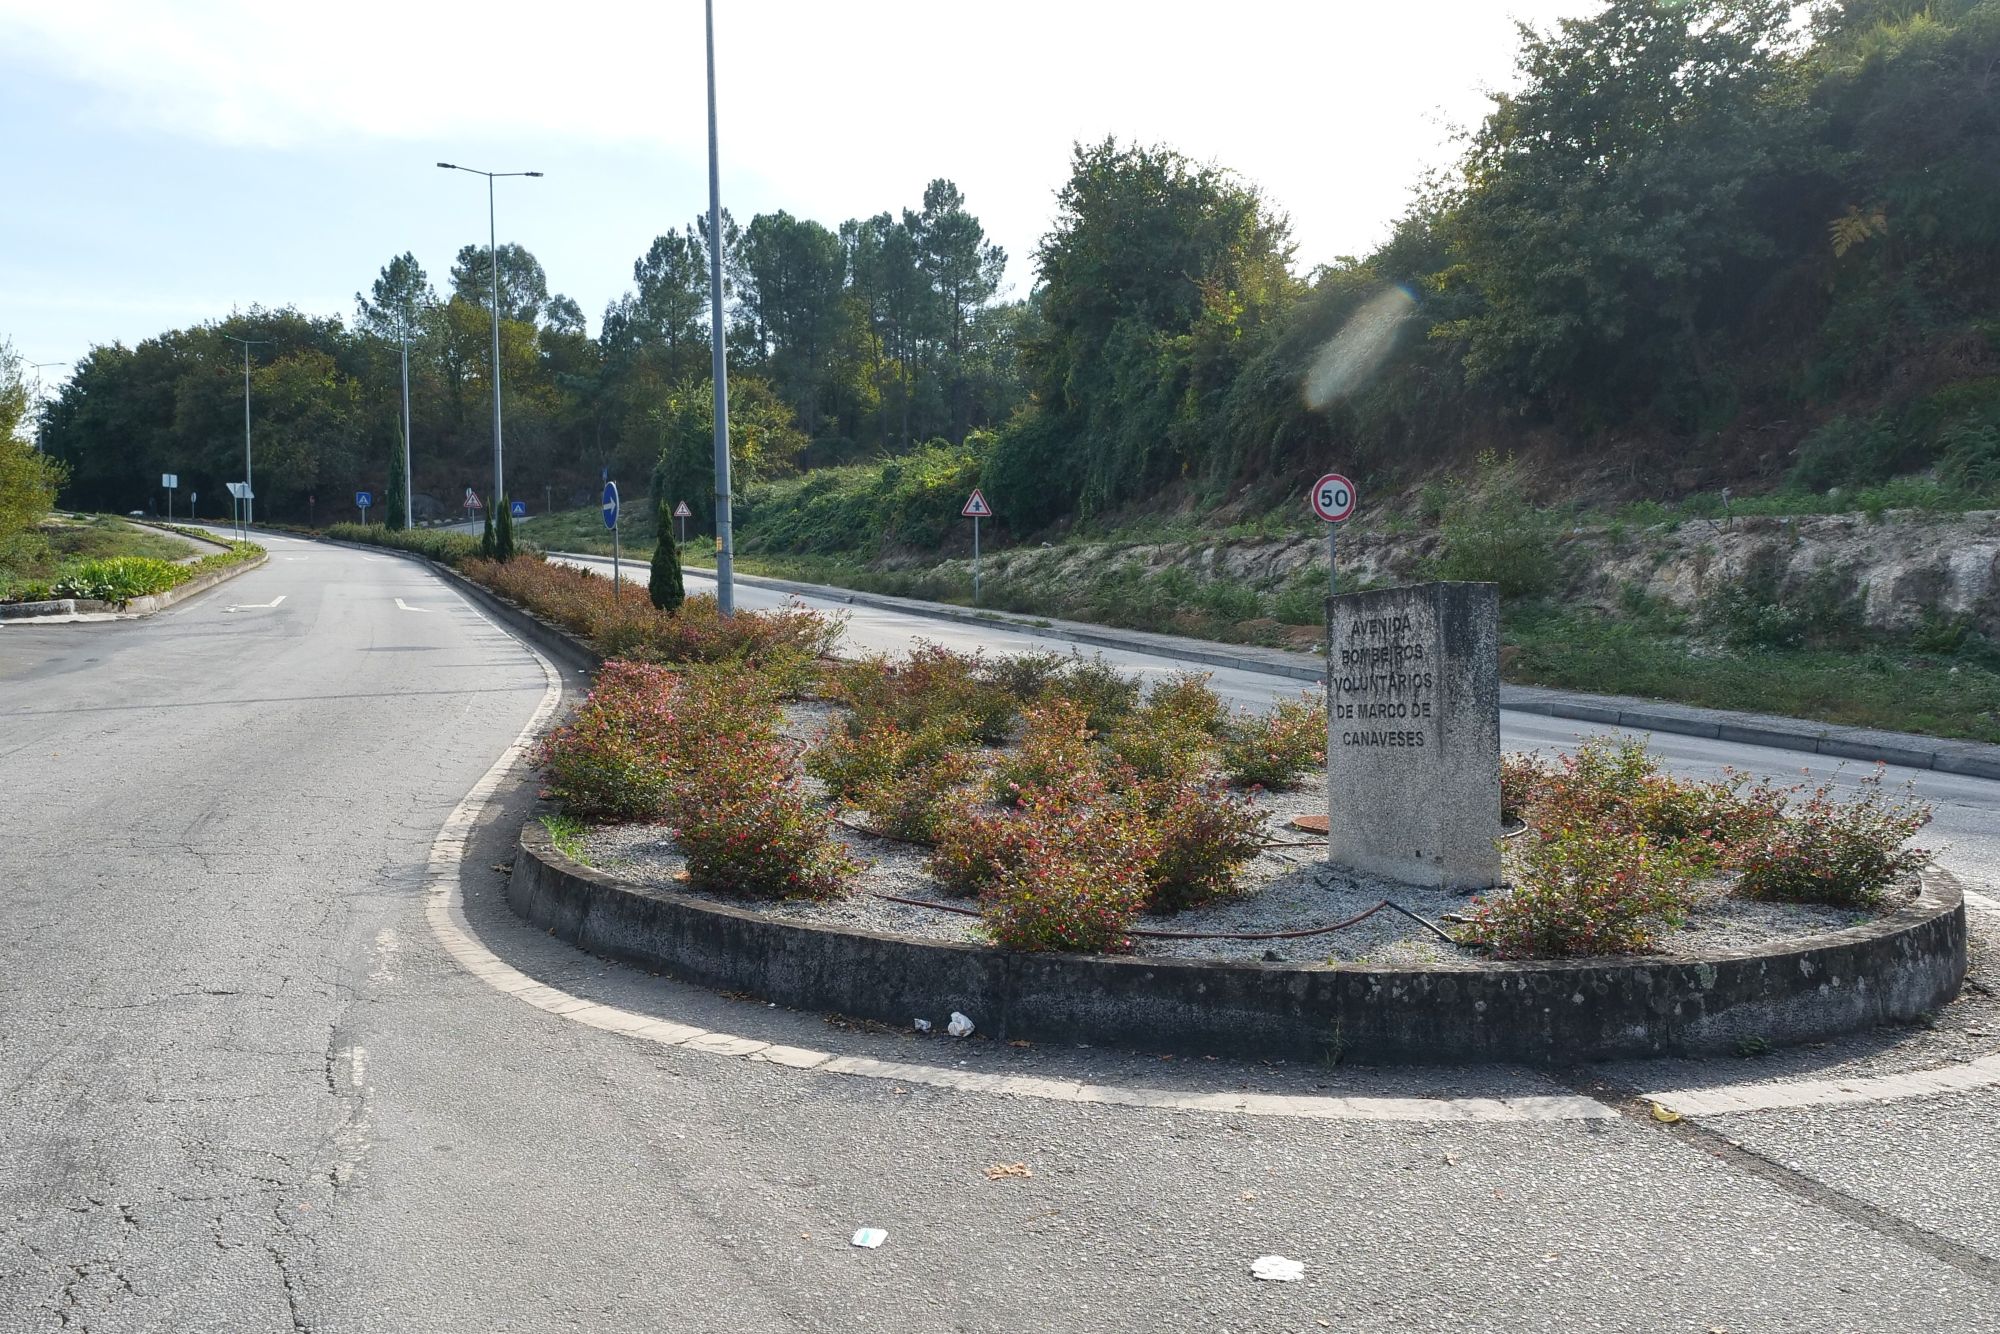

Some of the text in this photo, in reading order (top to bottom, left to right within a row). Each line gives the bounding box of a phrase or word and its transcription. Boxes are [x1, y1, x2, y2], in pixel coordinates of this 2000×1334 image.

[1321, 489, 1348, 507] 50
[1351, 615, 1411, 636] AVENIDA
[1342, 644, 1423, 665] BOMBEIROS
[1337, 704, 1353, 719] DE
[1411, 702, 1431, 718] DE
[1343, 731, 1424, 747] CANAVESES
